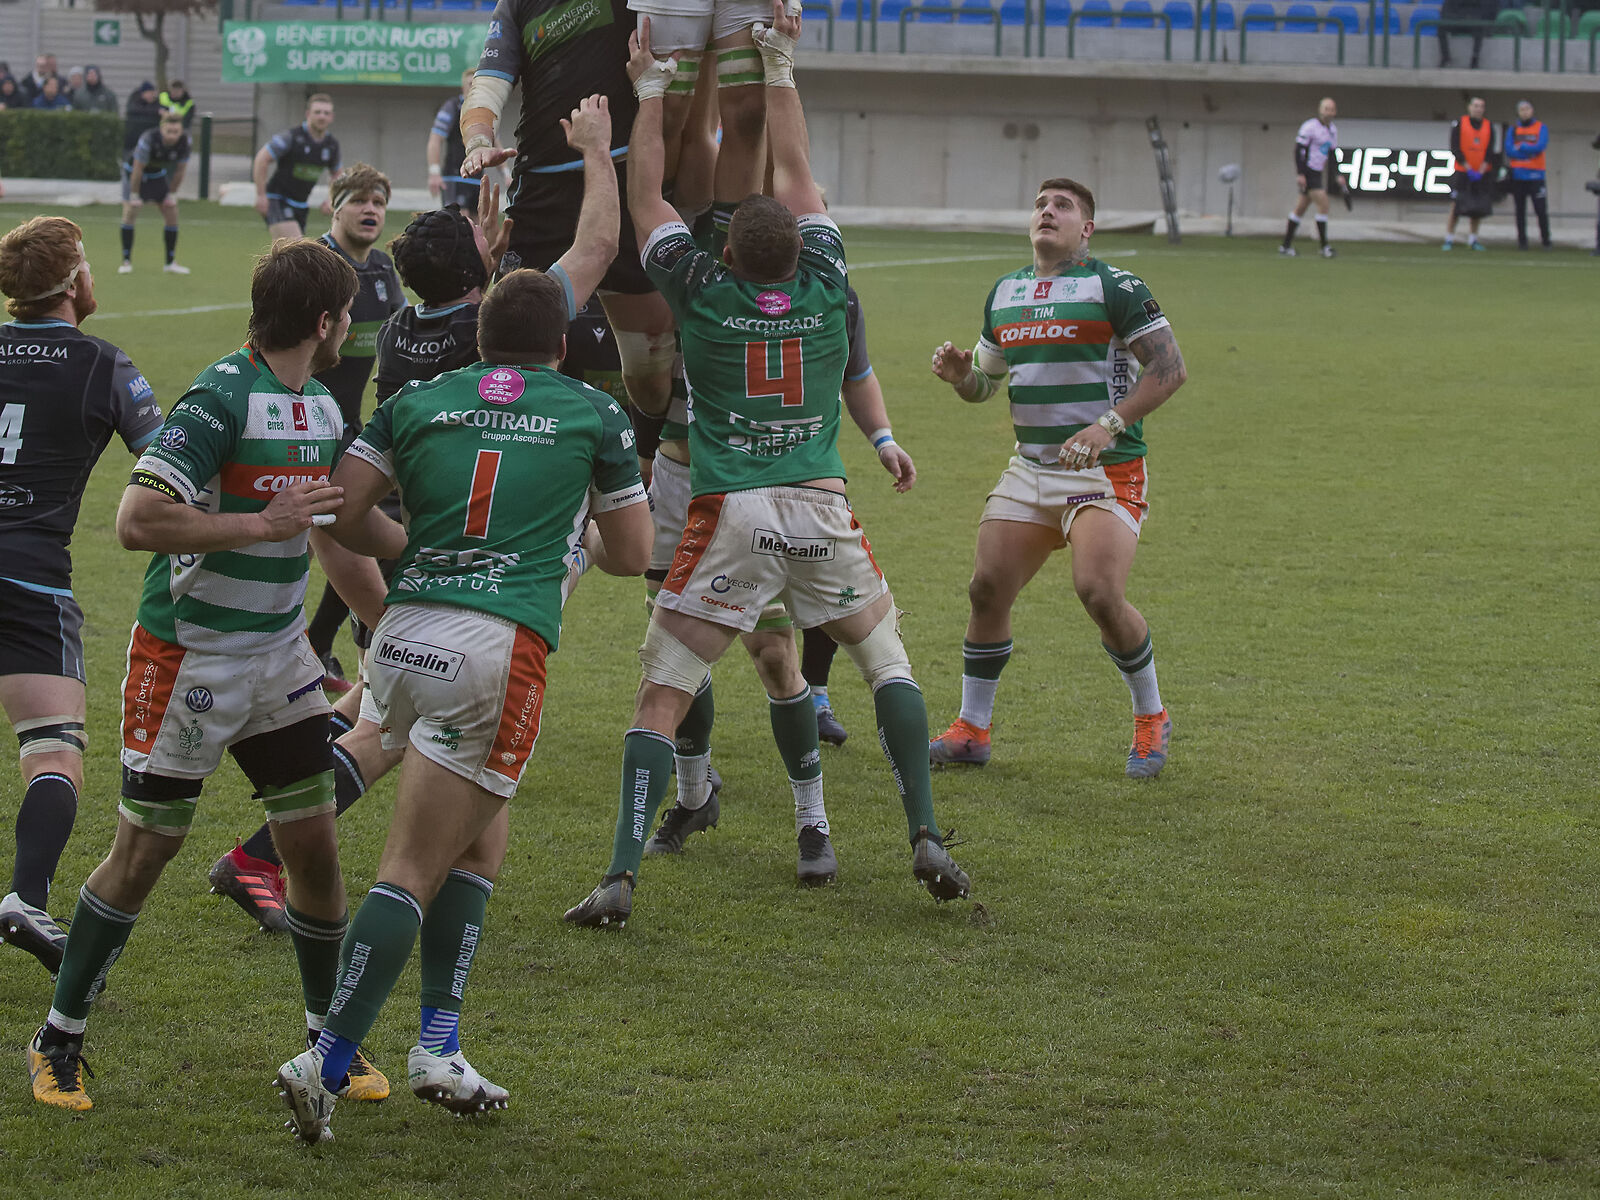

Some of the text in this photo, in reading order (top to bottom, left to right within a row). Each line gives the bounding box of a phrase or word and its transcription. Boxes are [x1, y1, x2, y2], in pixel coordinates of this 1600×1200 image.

[275, 25, 387, 47] BENETTON
[389, 28, 464, 49] RUGBY
[286, 50, 452, 73] SUPPORTERS CLUB
[722, 313, 824, 331] ASCOTRADE
[1034, 306, 1055, 319] TIM
[1001, 325, 1079, 343] COFILOC
[0, 344, 68, 359] ALCOLM
[745, 337, 804, 408] 4
[189, 404, 225, 432] Charge
[430, 409, 560, 435] ASCOTRADE
[481, 430, 555, 446] Gruppo Ascopiave
[157, 449, 192, 471] Automobili
[300, 445, 320, 462] TIM
[757, 445, 795, 457] MUT
[463, 449, 502, 540] 1
[612, 489, 644, 504] TERMOPLAS
[759, 536, 828, 558] Melcalin
[727, 577, 759, 591] VECOM
[700, 595, 747, 613] COFILOC
[379, 642, 450, 673] Melcalin
[632, 768, 651, 843] BENETTON RUGBY
[450, 923, 480, 1000] BENETTON RUGBY
[328, 941, 372, 1016] BENETTON RUGBY
